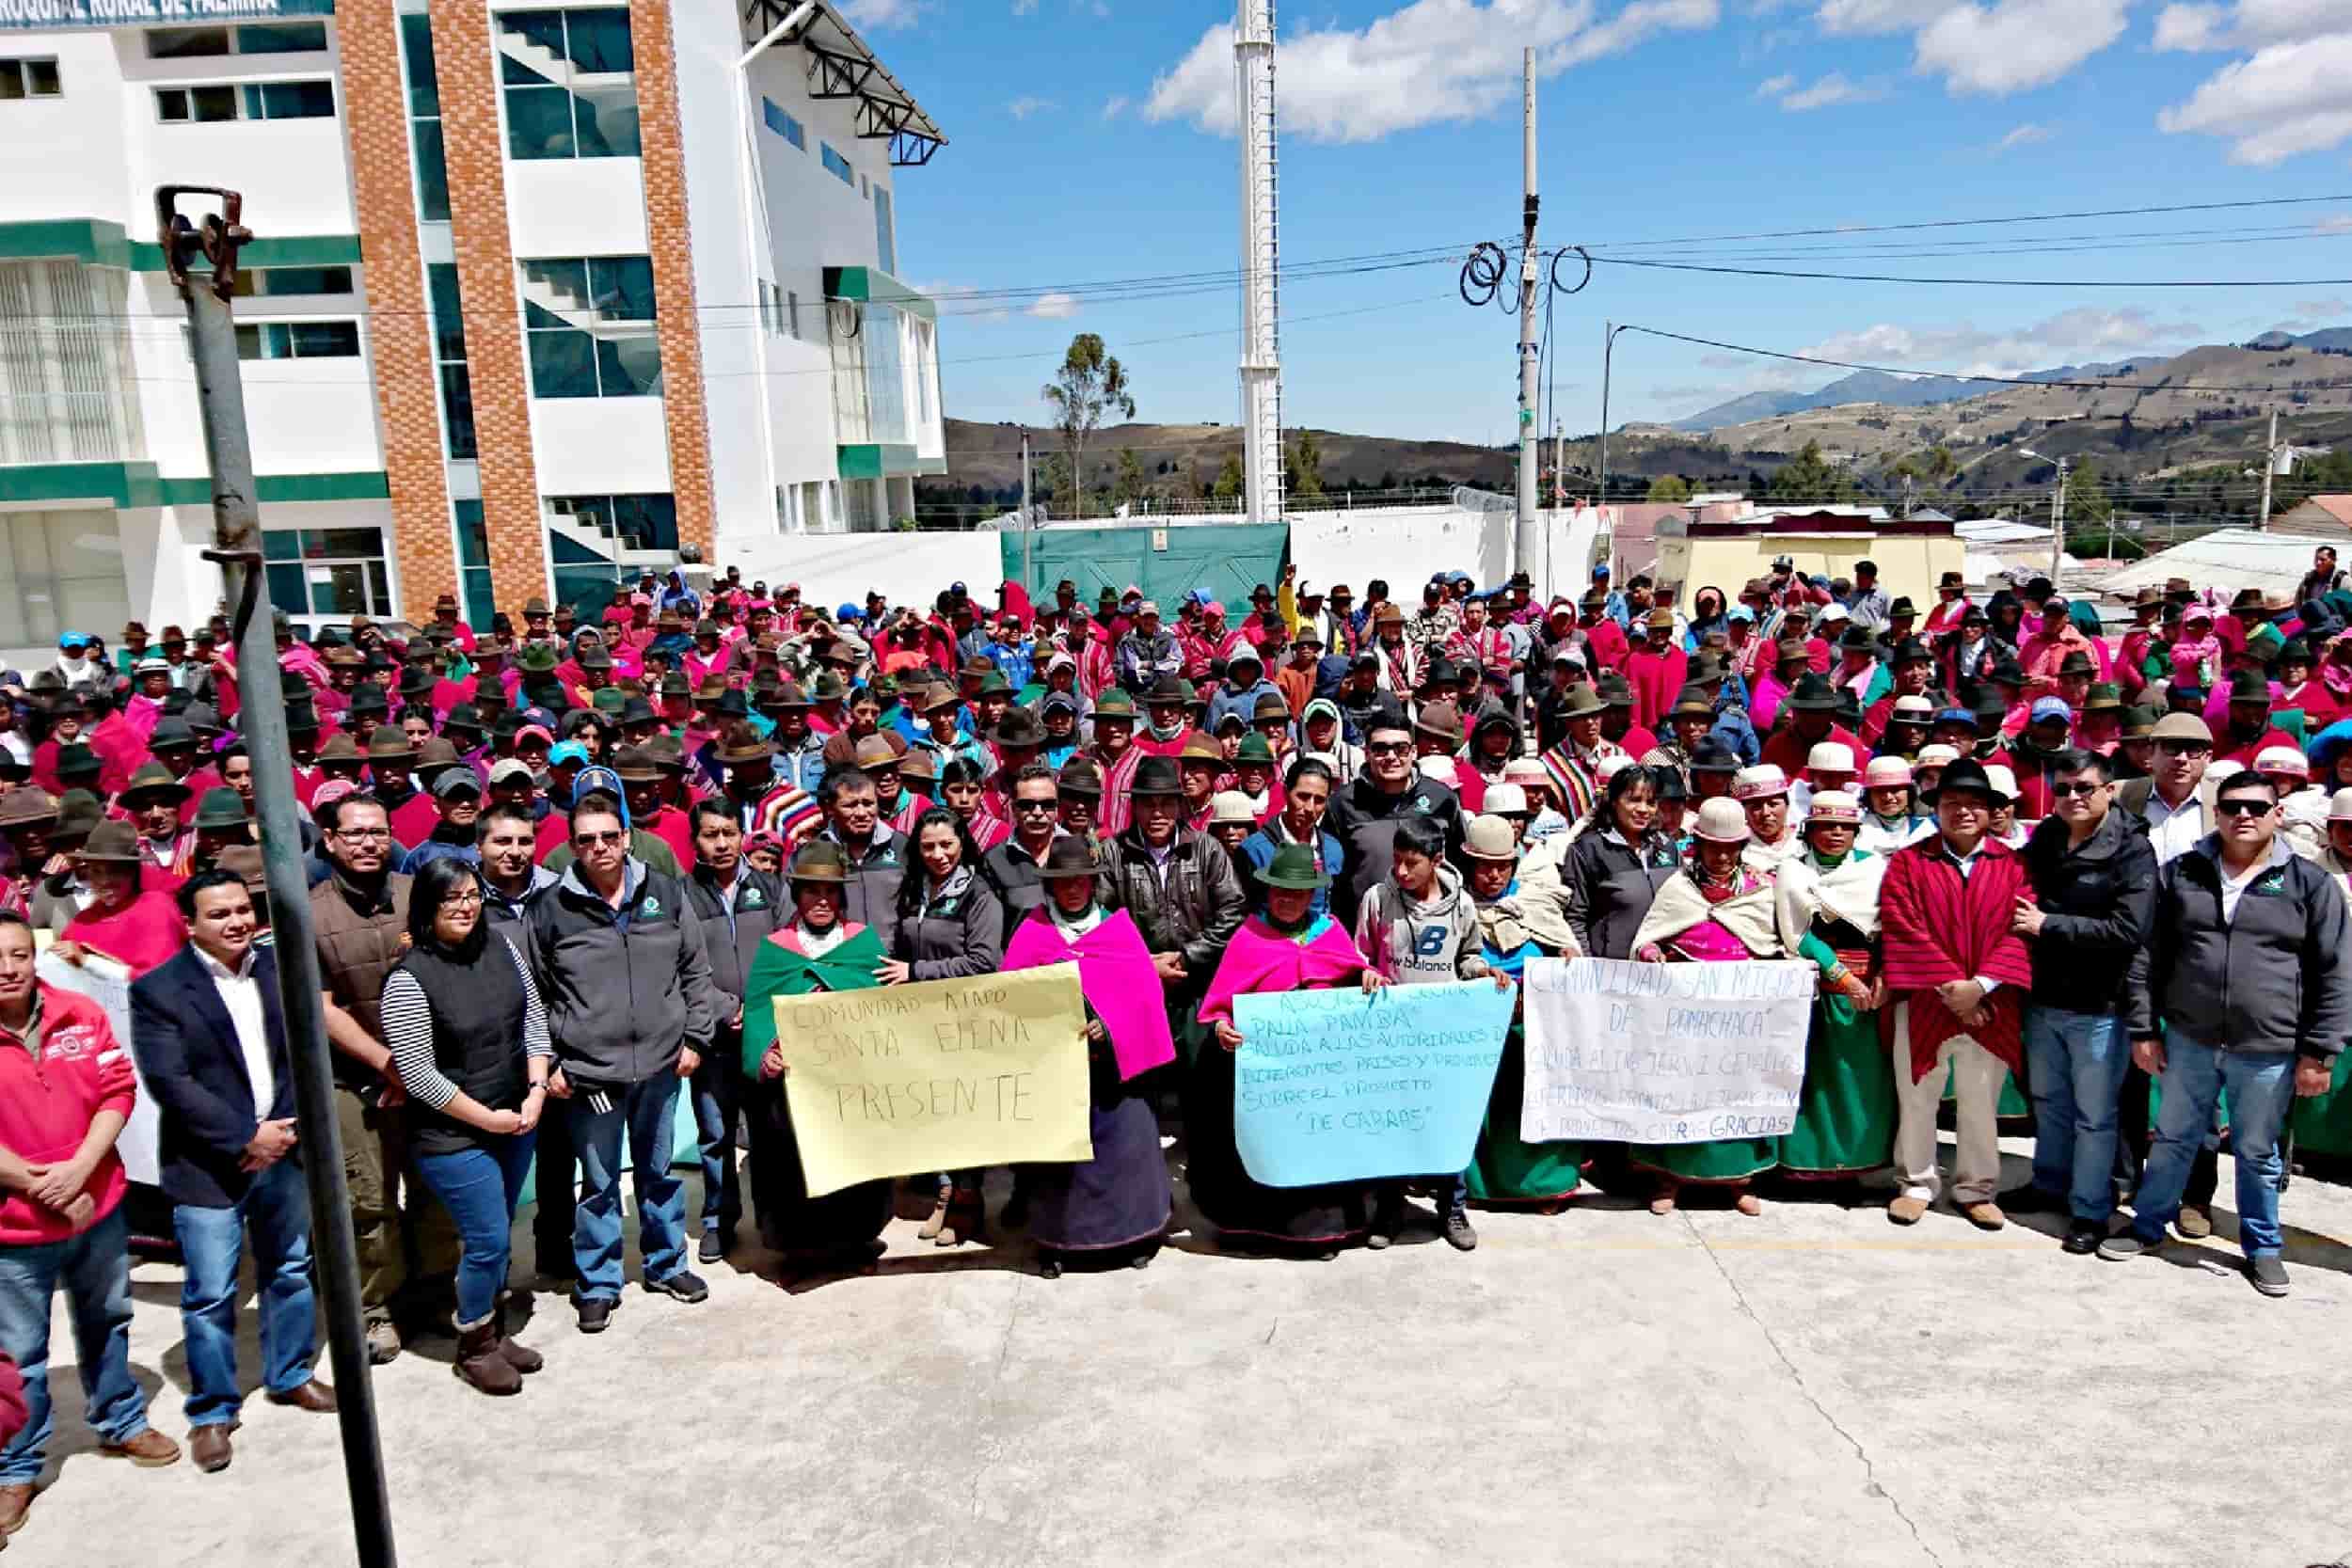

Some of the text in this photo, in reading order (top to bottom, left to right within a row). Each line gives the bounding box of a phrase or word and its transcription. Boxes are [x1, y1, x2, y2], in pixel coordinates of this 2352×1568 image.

[813, 1027, 901, 1067] SANTA
[834, 1071, 1036, 1124] PRESENTE
[1709, 1114, 1793, 1137] GRACIAS
